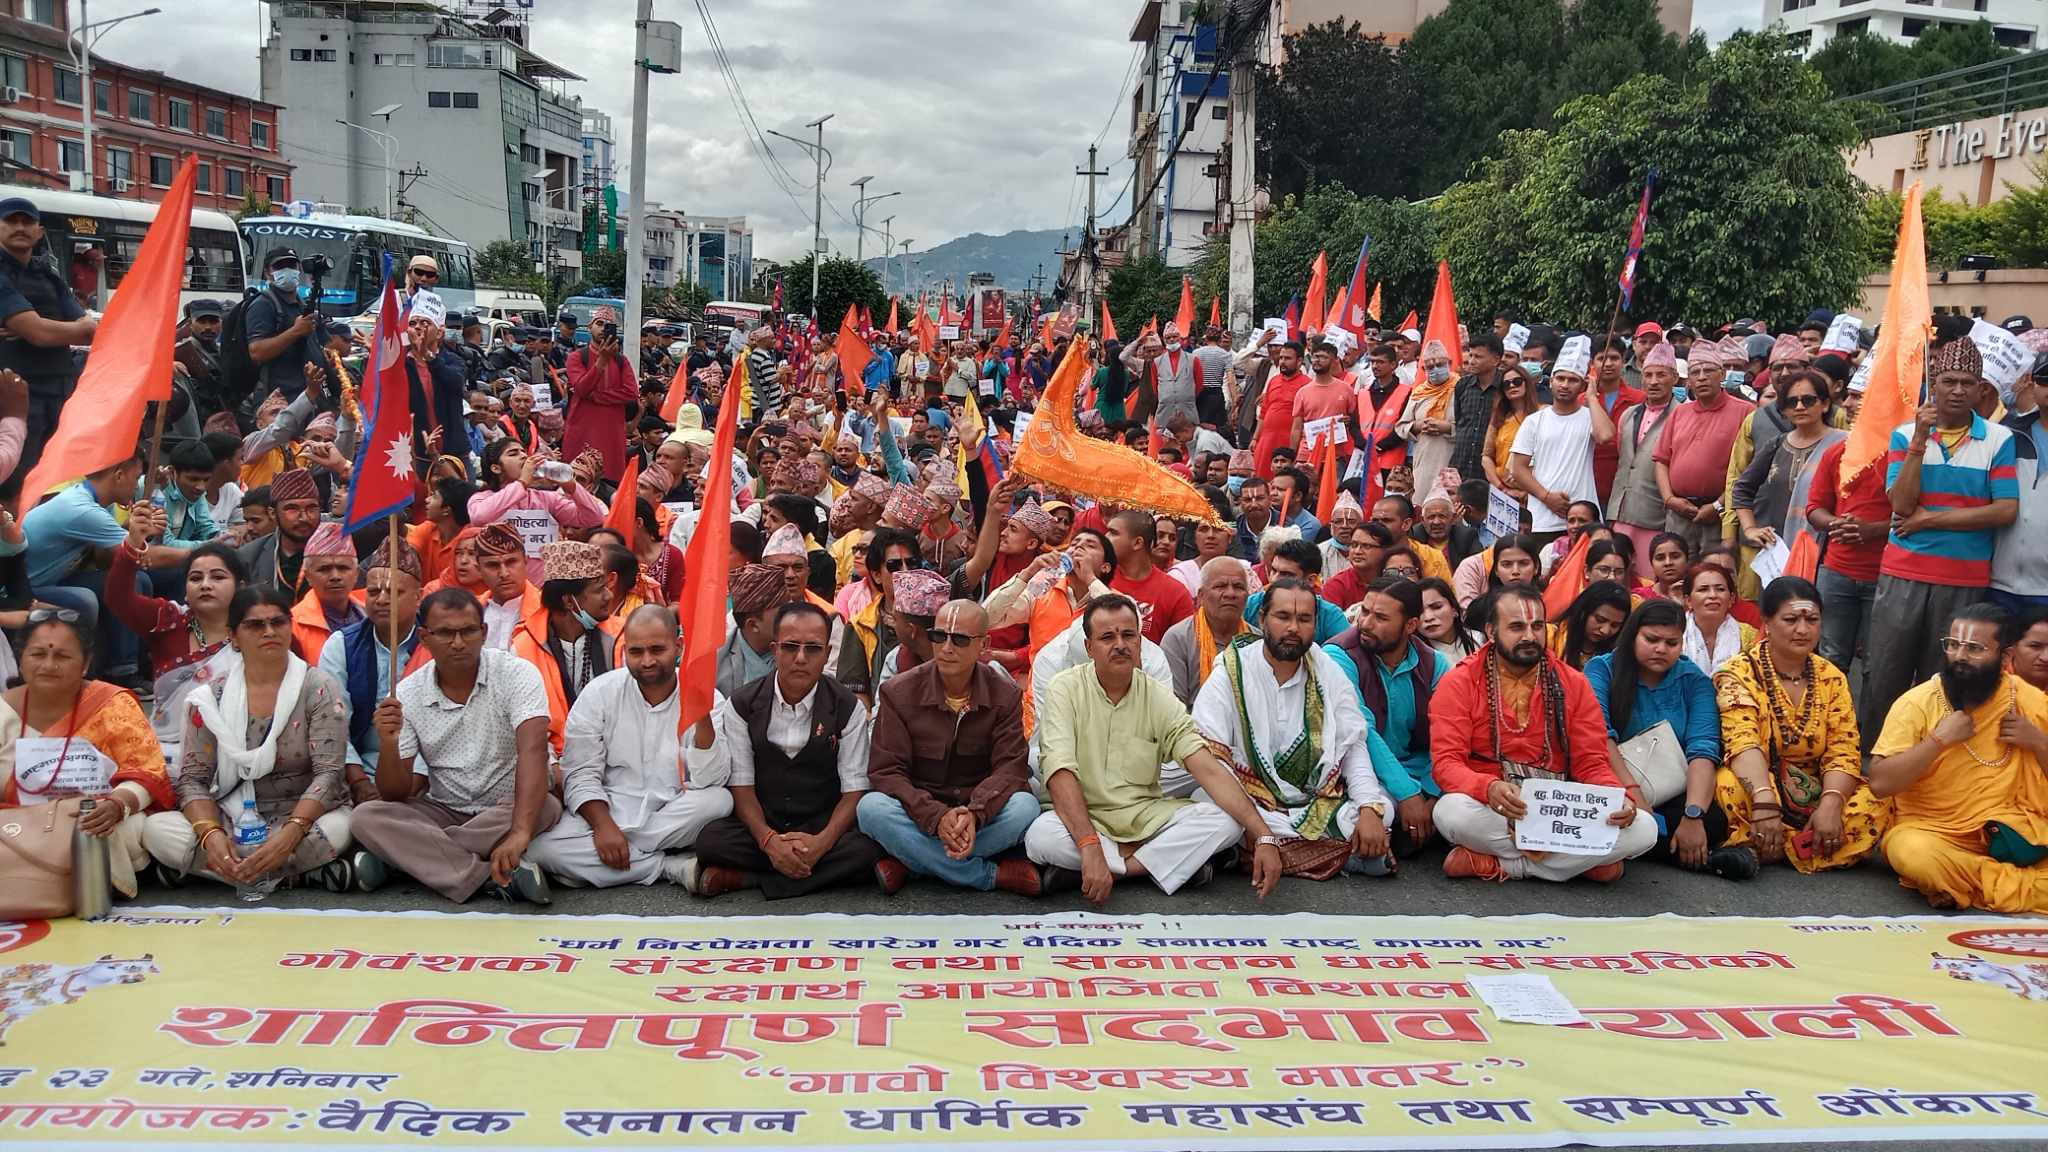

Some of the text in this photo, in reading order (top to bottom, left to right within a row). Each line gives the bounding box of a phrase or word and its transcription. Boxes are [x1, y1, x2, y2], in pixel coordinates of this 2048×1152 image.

[1937, 121, 1984, 167] The
[1993, 111, 2047, 159] Eve
[241, 225, 353, 242] TOURIST
[1573, 807, 1600, 820] एउटै
[637, 938, 814, 950] निरपेक्षता
[829, 937, 939, 949] खारेज
[954, 939, 1008, 948] गर
[1023, 936, 1121, 947] वैदिक
[1137, 938, 1267, 947] सनातन
[1373, 939, 1482, 948] कायम
[279, 951, 1792, 974] गोवंशको संरक्षण तथा सनातन धर्म-संस्कृतिको
[655, 976, 1469, 1001] रक्षार्थ आयोजित विशाल
[163, 1000, 902, 1060] शान्तिपूर्ण
[50, 1071, 108, 1087] २३
[982, 1064, 1247, 1089] विश्वस्य
[319, 1100, 524, 1136] वैदिक
[564, 1109, 806, 1136] सनातन
[845, 1100, 1088, 1131] धार्मिक
[1124, 1098, 1364, 1130] महासंघ
[1399, 1101, 1531, 1124] तथा
[1563, 1091, 1780, 1126] सम्पूर्ण
